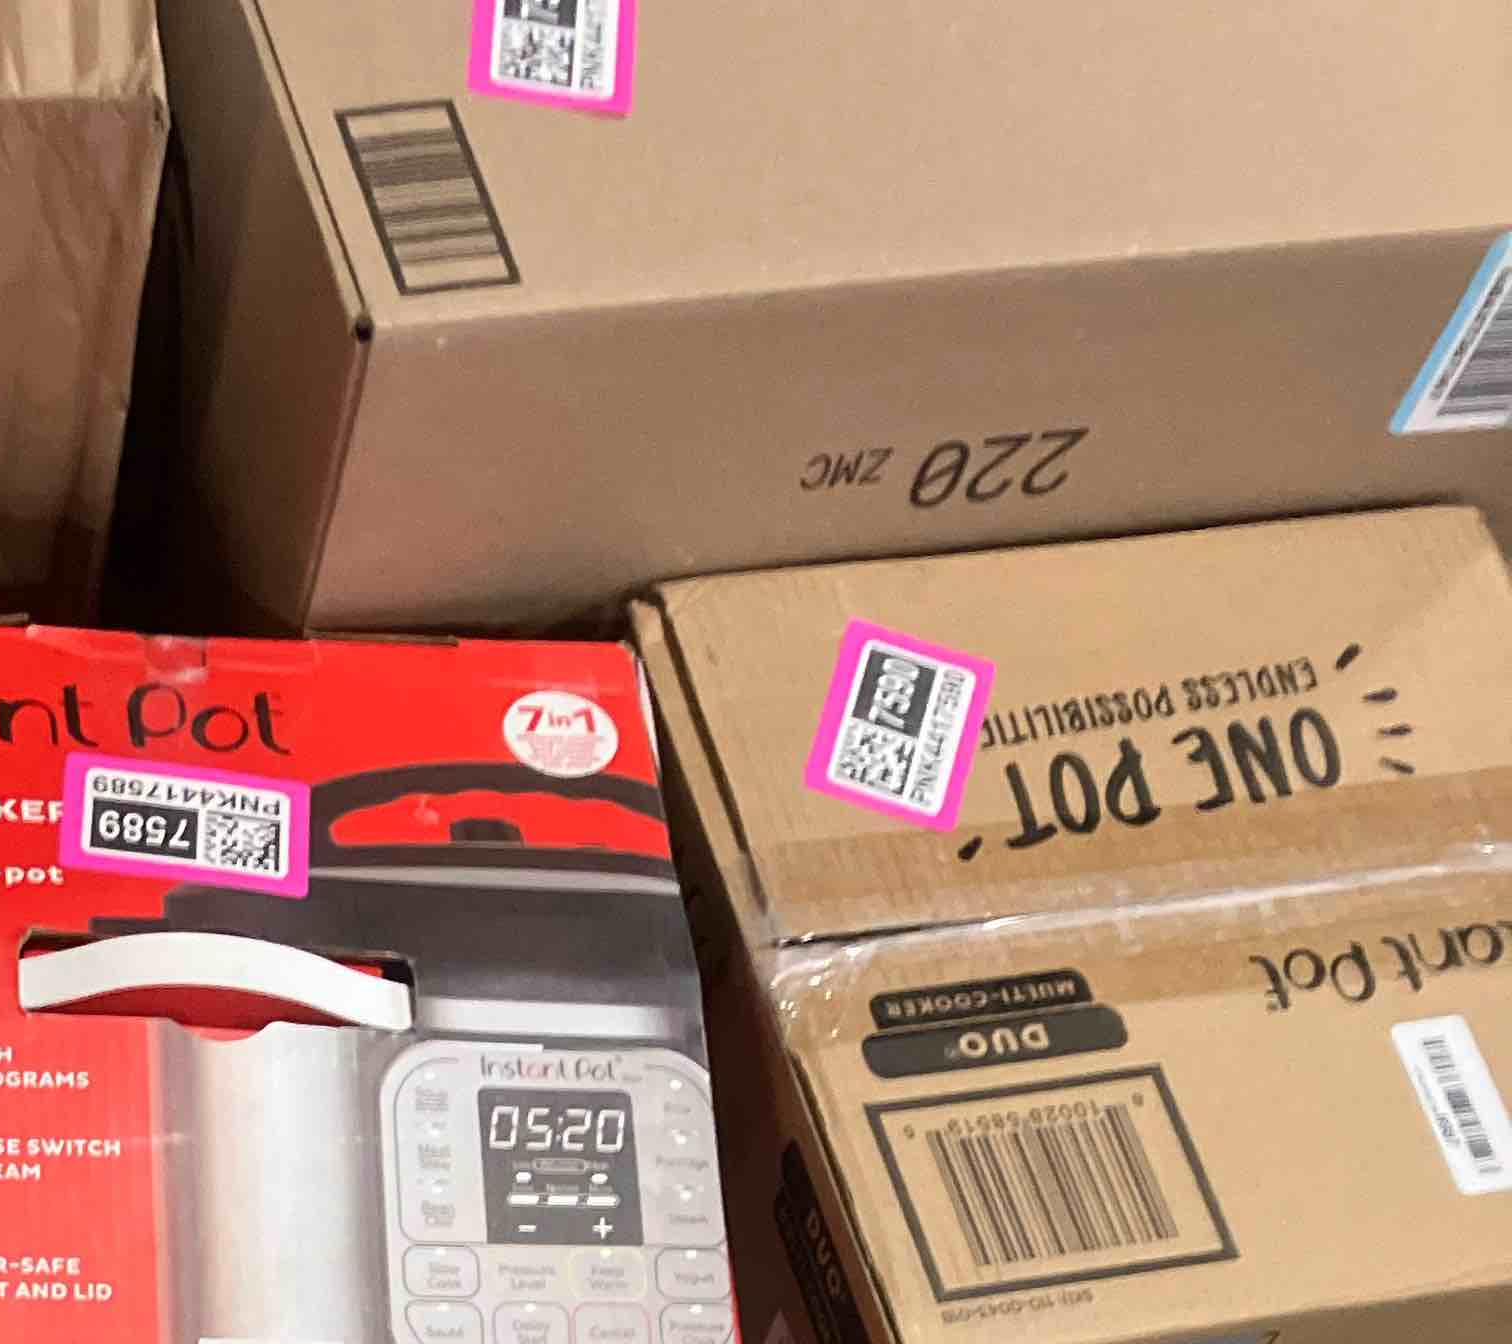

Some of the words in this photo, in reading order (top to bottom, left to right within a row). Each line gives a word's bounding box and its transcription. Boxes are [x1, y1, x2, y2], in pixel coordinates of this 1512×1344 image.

[801, 447, 891, 491] ZMC
[908, 426, 1088, 508] 220
[1187, 658, 1319, 710] ENDLESS
[124, 681, 292, 756] Pot
[979, 676, 1178, 748] POSSIBILITIE
[1171, 705, 1342, 813] ONE
[92, 774, 282, 818] PNK4417589
[1005, 737, 1163, 851] POT
[97, 808, 191, 851] 7589
[1248, 942, 1376, 1014] Pot
[1382, 921, 1512, 992] ant
[885, 979, 1077, 1018] MULTI-COOKER
[944, 1022, 1051, 1059] DUO
[480, 1055, 570, 1082] Instant
[572, 1060, 619, 1082] Pot
[27, 1137, 121, 1158] SWITCH
[488, 1104, 626, 1153] 05:20
[15, 1280, 68, 1300] AND
[72, 1281, 114, 1302] LID
